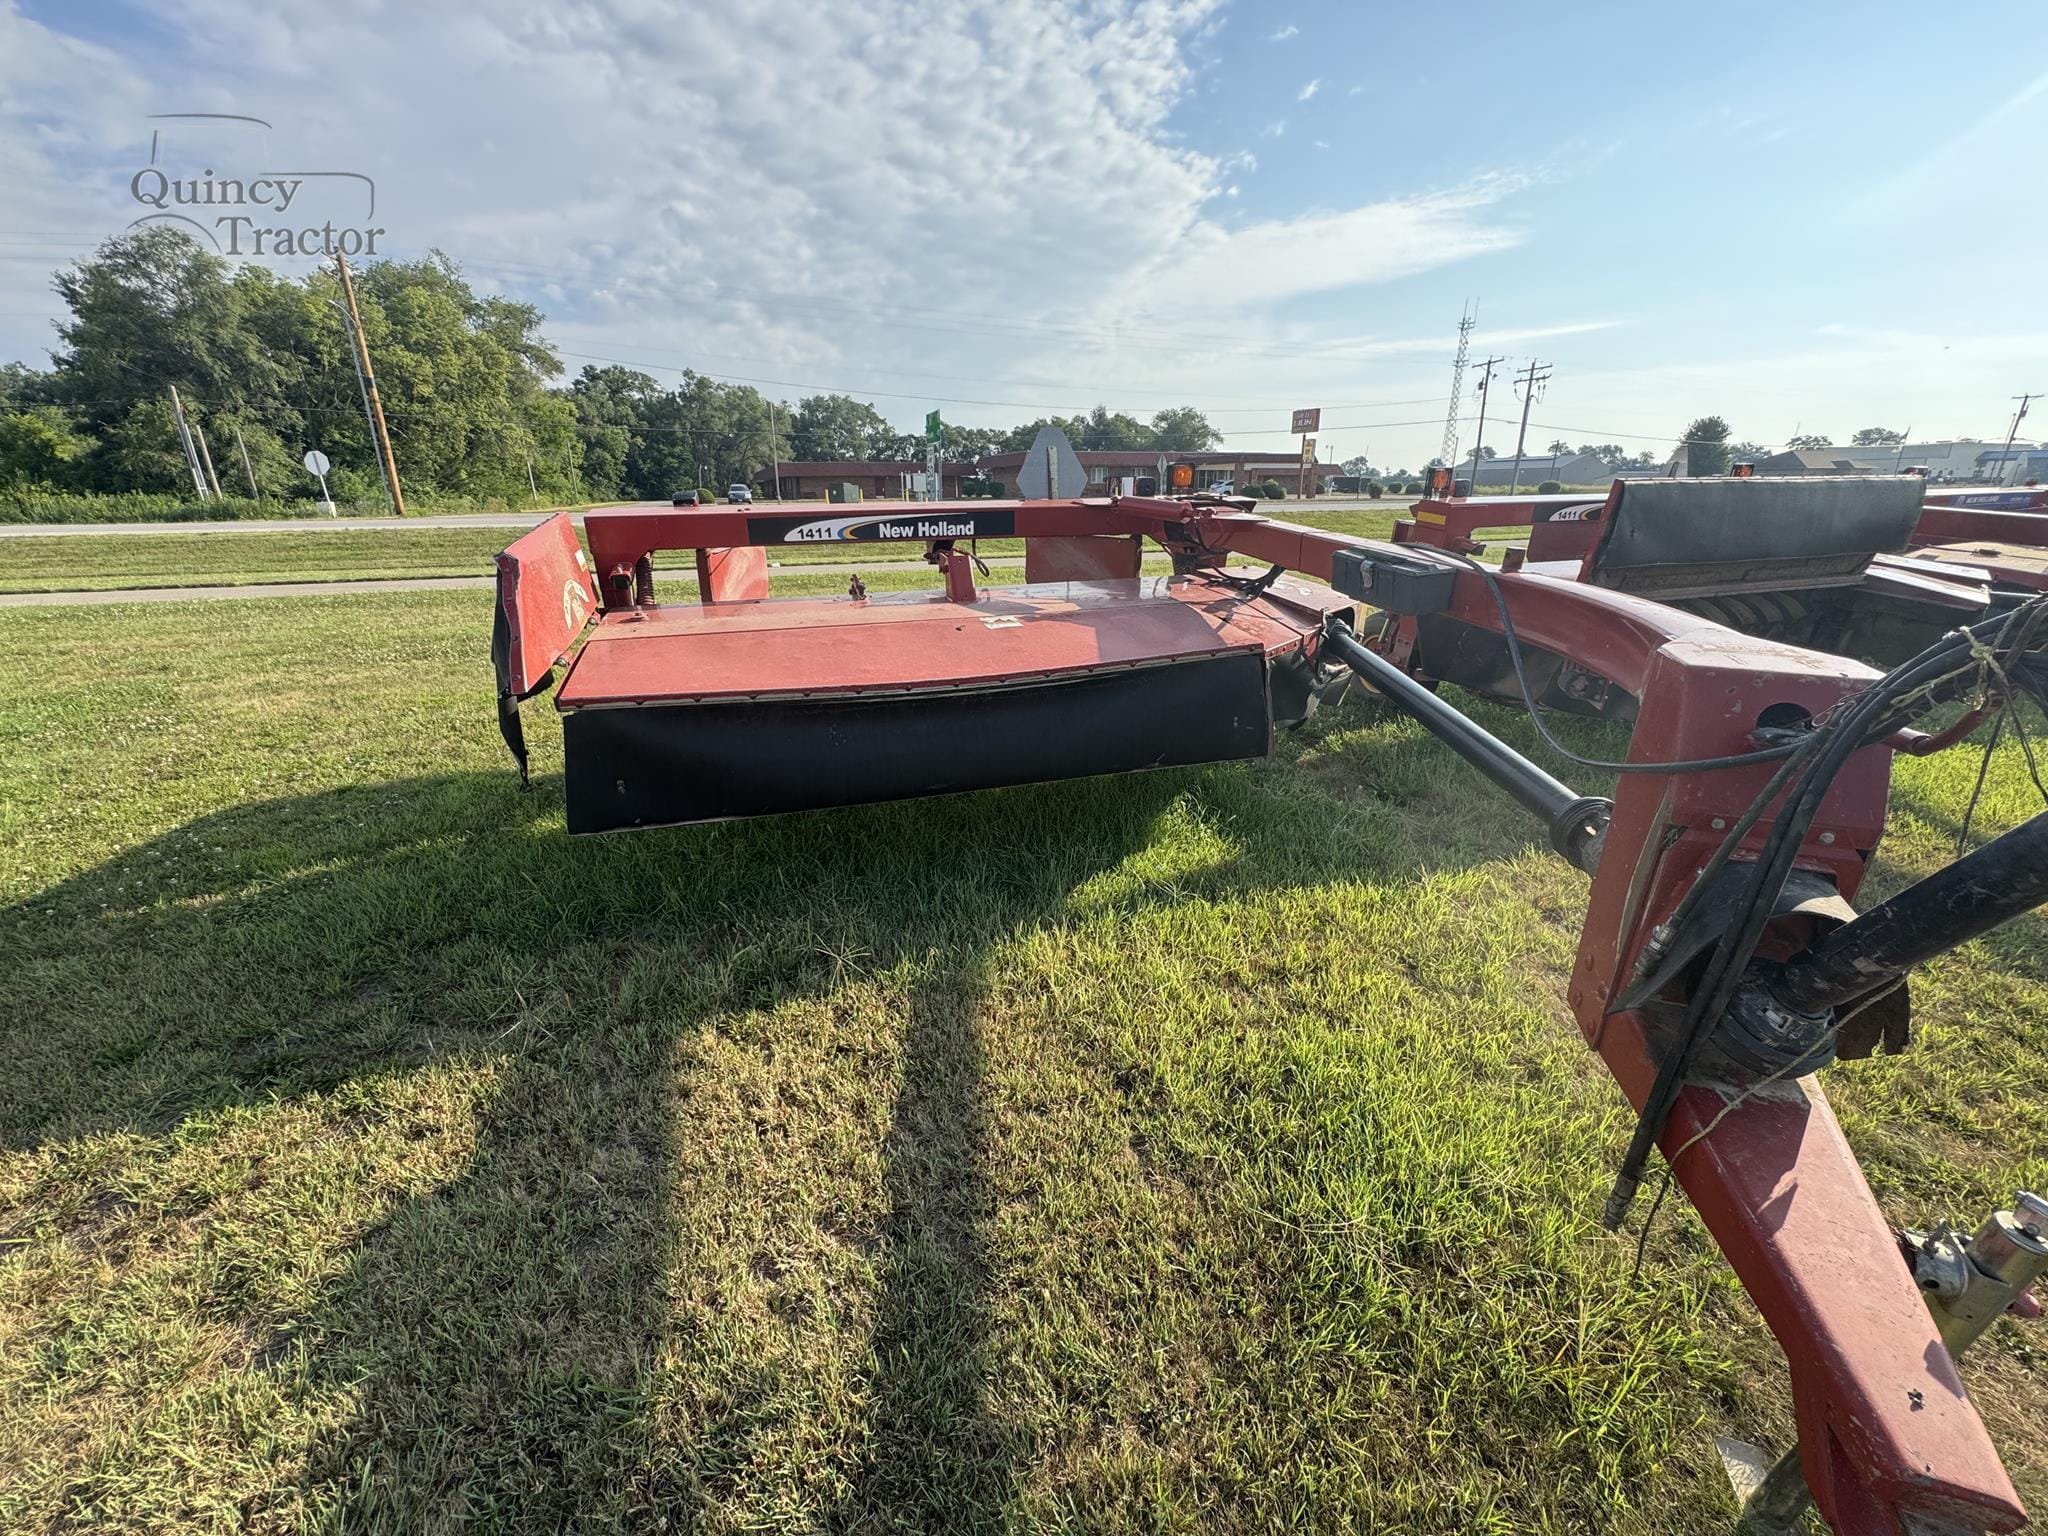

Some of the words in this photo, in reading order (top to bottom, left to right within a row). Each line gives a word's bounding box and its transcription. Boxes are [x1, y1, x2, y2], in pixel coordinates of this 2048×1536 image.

[1558, 511, 1577, 519] 1411
[797, 527, 832, 540] 1411
[879, 523, 915, 538] New
[918, 521, 974, 537] Holland
